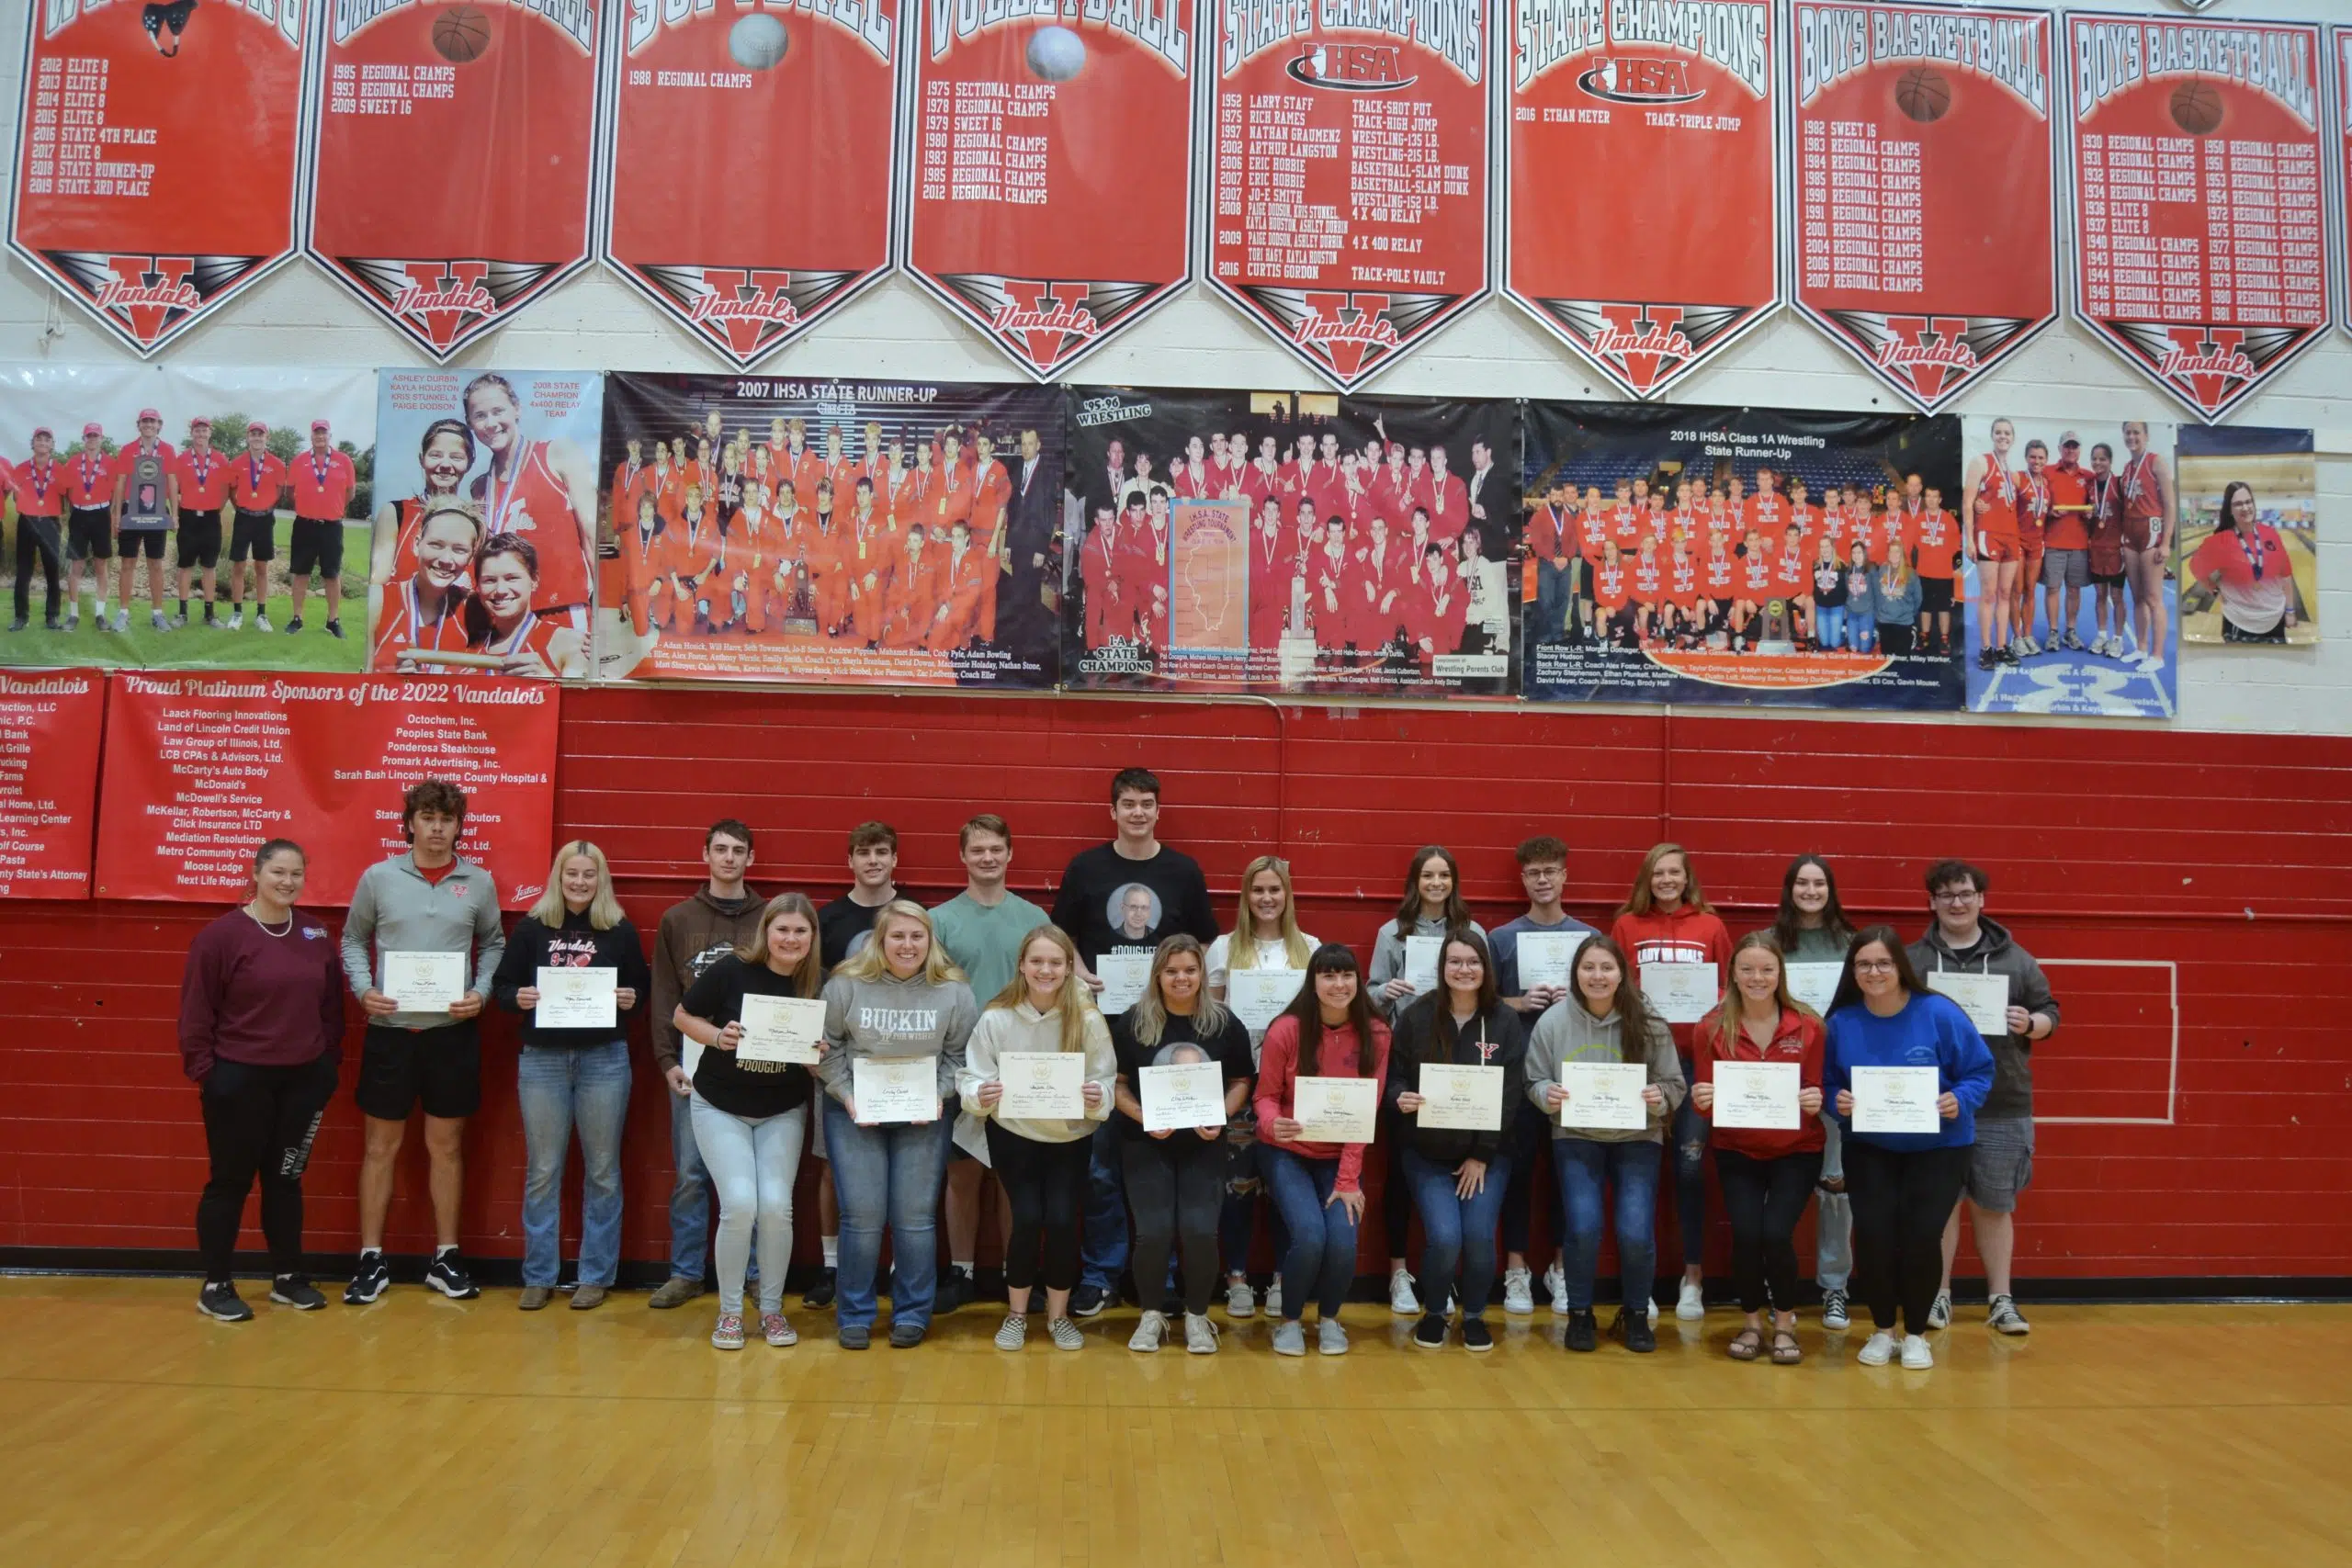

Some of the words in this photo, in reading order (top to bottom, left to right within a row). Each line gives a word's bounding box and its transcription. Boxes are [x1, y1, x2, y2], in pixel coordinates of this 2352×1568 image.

[1223, 0, 1311, 74] STATE
[1319, 0, 1482, 83] CHAMPIONS
[1517, 0, 1604, 88] STATE
[1611, 0, 1767, 96] CHAMPIONS
[40, 58, 62, 73] 2012
[68, 59, 99, 73] ELITE
[102, 60, 108, 73] 8
[1800, 8, 1867, 102] BOYS
[1872, 11, 2045, 115] BASKETBALL
[334, 64, 356, 79] 1985
[362, 66, 410, 80] REGIONAL
[414, 66, 456, 81] CHAMPS
[629, 71, 650, 85] 1988
[658, 72, 707, 87] REGIONAL
[711, 73, 752, 88] CHAMPS
[2076, 22, 2141, 116] BOYS
[2145, 27, 2315, 128] BASKETBALL
[928, 81, 950, 96] 1975
[956, 82, 1011, 97] SECTIONAL
[1014, 85, 1056, 99] CHAMPS
[332, 99, 356, 113] 2009
[360, 100, 397, 114] SWEET
[401, 100, 412, 114] 16
[1222, 94, 1241, 107] 1952
[1250, 96, 1280, 109] LARRY
[1283, 96, 1313, 111] STAFF
[1352, 99, 1410, 115] TRACK-SHOT
[1413, 102, 1431, 116] PUT
[1516, 107, 1535, 121] 2016
[1544, 107, 1575, 122] ETHAN
[1578, 109, 1610, 124] MEYER
[1645, 112, 1712, 129] TRACK-TRIPLE
[1715, 116, 1740, 130] JUMP
[34, 127, 55, 141] 2016
[62, 127, 96, 141] STATE
[99, 129, 120, 143] 4TH
[123, 130, 157, 144] PLACE
[1222, 126, 1240, 138] 1997
[1250, 126, 1288, 140] NATHAN
[1352, 130, 1422, 146] WRESTLING-135
[1425, 134, 1439, 147] LB.
[1804, 120, 1825, 135] 1982
[1831, 121, 1863, 137] SWEET
[1867, 123, 1876, 138] 16
[2083, 134, 2102, 149] 1930
[2109, 135, 2154, 152] REGIONAL
[2157, 138, 2194, 152] CHAMPS
[29, 179, 52, 193] 2019
[58, 179, 90, 194] STATE
[94, 181, 113, 195] 3RD
[117, 181, 151, 196] PLACE
[1220, 173, 1242, 185] 2007
[1249, 173, 1269, 186] ERIC
[1273, 175, 1306, 188] HOBBIE
[1351, 177, 1441, 194] BASKETBALL-SLAM
[1444, 182, 1469, 195] DUNK
[923, 185, 945, 199] 2012
[952, 186, 1001, 201] REGIONAL
[1005, 188, 1047, 204] CHAMPS
[2086, 219, 2106, 232] 1937
[2111, 220, 2139, 233] ELITE
[2143, 220, 2149, 233] 8
[2209, 241, 2229, 254] 1977
[2234, 241, 2278, 256] REGIONAL
[2282, 243, 2319, 257] CHAMPS
[1219, 263, 1238, 276] 2016
[1248, 263, 1281, 277] CURTIS
[1284, 264, 1318, 279] GORDON
[1352, 266, 1410, 283] TRACK-POLE
[1414, 270, 1445, 285] VAULT
[96, 276, 203, 308] Vandals
[692, 287, 800, 324] Vandals
[1294, 314, 1399, 346] Vandals
[1878, 336, 1979, 369] Vandals
[2159, 347, 2258, 378] Vandals
[738, 381, 770, 398] 2007
[775, 384, 807, 399] IHSA
[812, 386, 854, 400] STATE
[858, 386, 937, 402] RUNNER-UP
[1077, 405, 1150, 425] WRESTLING
[1670, 431, 1696, 441] 2018
[1700, 432, 1726, 442] IHSA
[1729, 433, 1758, 443] Class
[1762, 434, 1775, 444] 1A
[1778, 434, 1825, 448] Wrestling
[1705, 446, 1732, 456] State
[1736, 446, 1792, 459] Runner-Up
[987, 651, 1011, 660] Bowling
[1097, 649, 1137, 660] STATE
[1080, 661, 1152, 671] CHAMPIONS
[1436, 665, 1464, 673] Wrestling
[127, 676, 181, 695] Proud
[186, 680, 267, 698] Platinum
[272, 681, 345, 704] Sponsors
[349, 683, 369, 706] of
[371, 684, 399, 702] the
[402, 683, 448, 702] 2022
[453, 684, 546, 705] Vandalois
[163, 708, 190, 718] Laack
[194, 709, 232, 721] Flooring
[235, 710, 287, 721] Innovations
[408, 715, 458, 726] Octochem,
[461, 716, 477, 726] Inc.
[397, 728, 435, 739] Peoples
[437, 730, 461, 739] State
[464, 730, 487, 740] Bank
[388, 742, 438, 752] Ponderosa
[441, 743, 496, 754] Steakhouse
[174, 765, 220, 776] McCarty's
[223, 766, 243, 775] Auto
[245, 767, 268, 778] Body
[195, 780, 246, 789] McDonald's
[166, 832, 210, 843] Mediation
[214, 833, 266, 845] Resolutions
[51, 870, 87, 881] Attorney
[185, 862, 214, 871] Moose
[217, 863, 243, 874] Lodge
[177, 875, 198, 885] Next
[201, 875, 217, 886] Life
[220, 877, 249, 887] Repair
[859, 1007, 937, 1032] BUCKIN
[1476, 1042, 1499, 1059] Y
